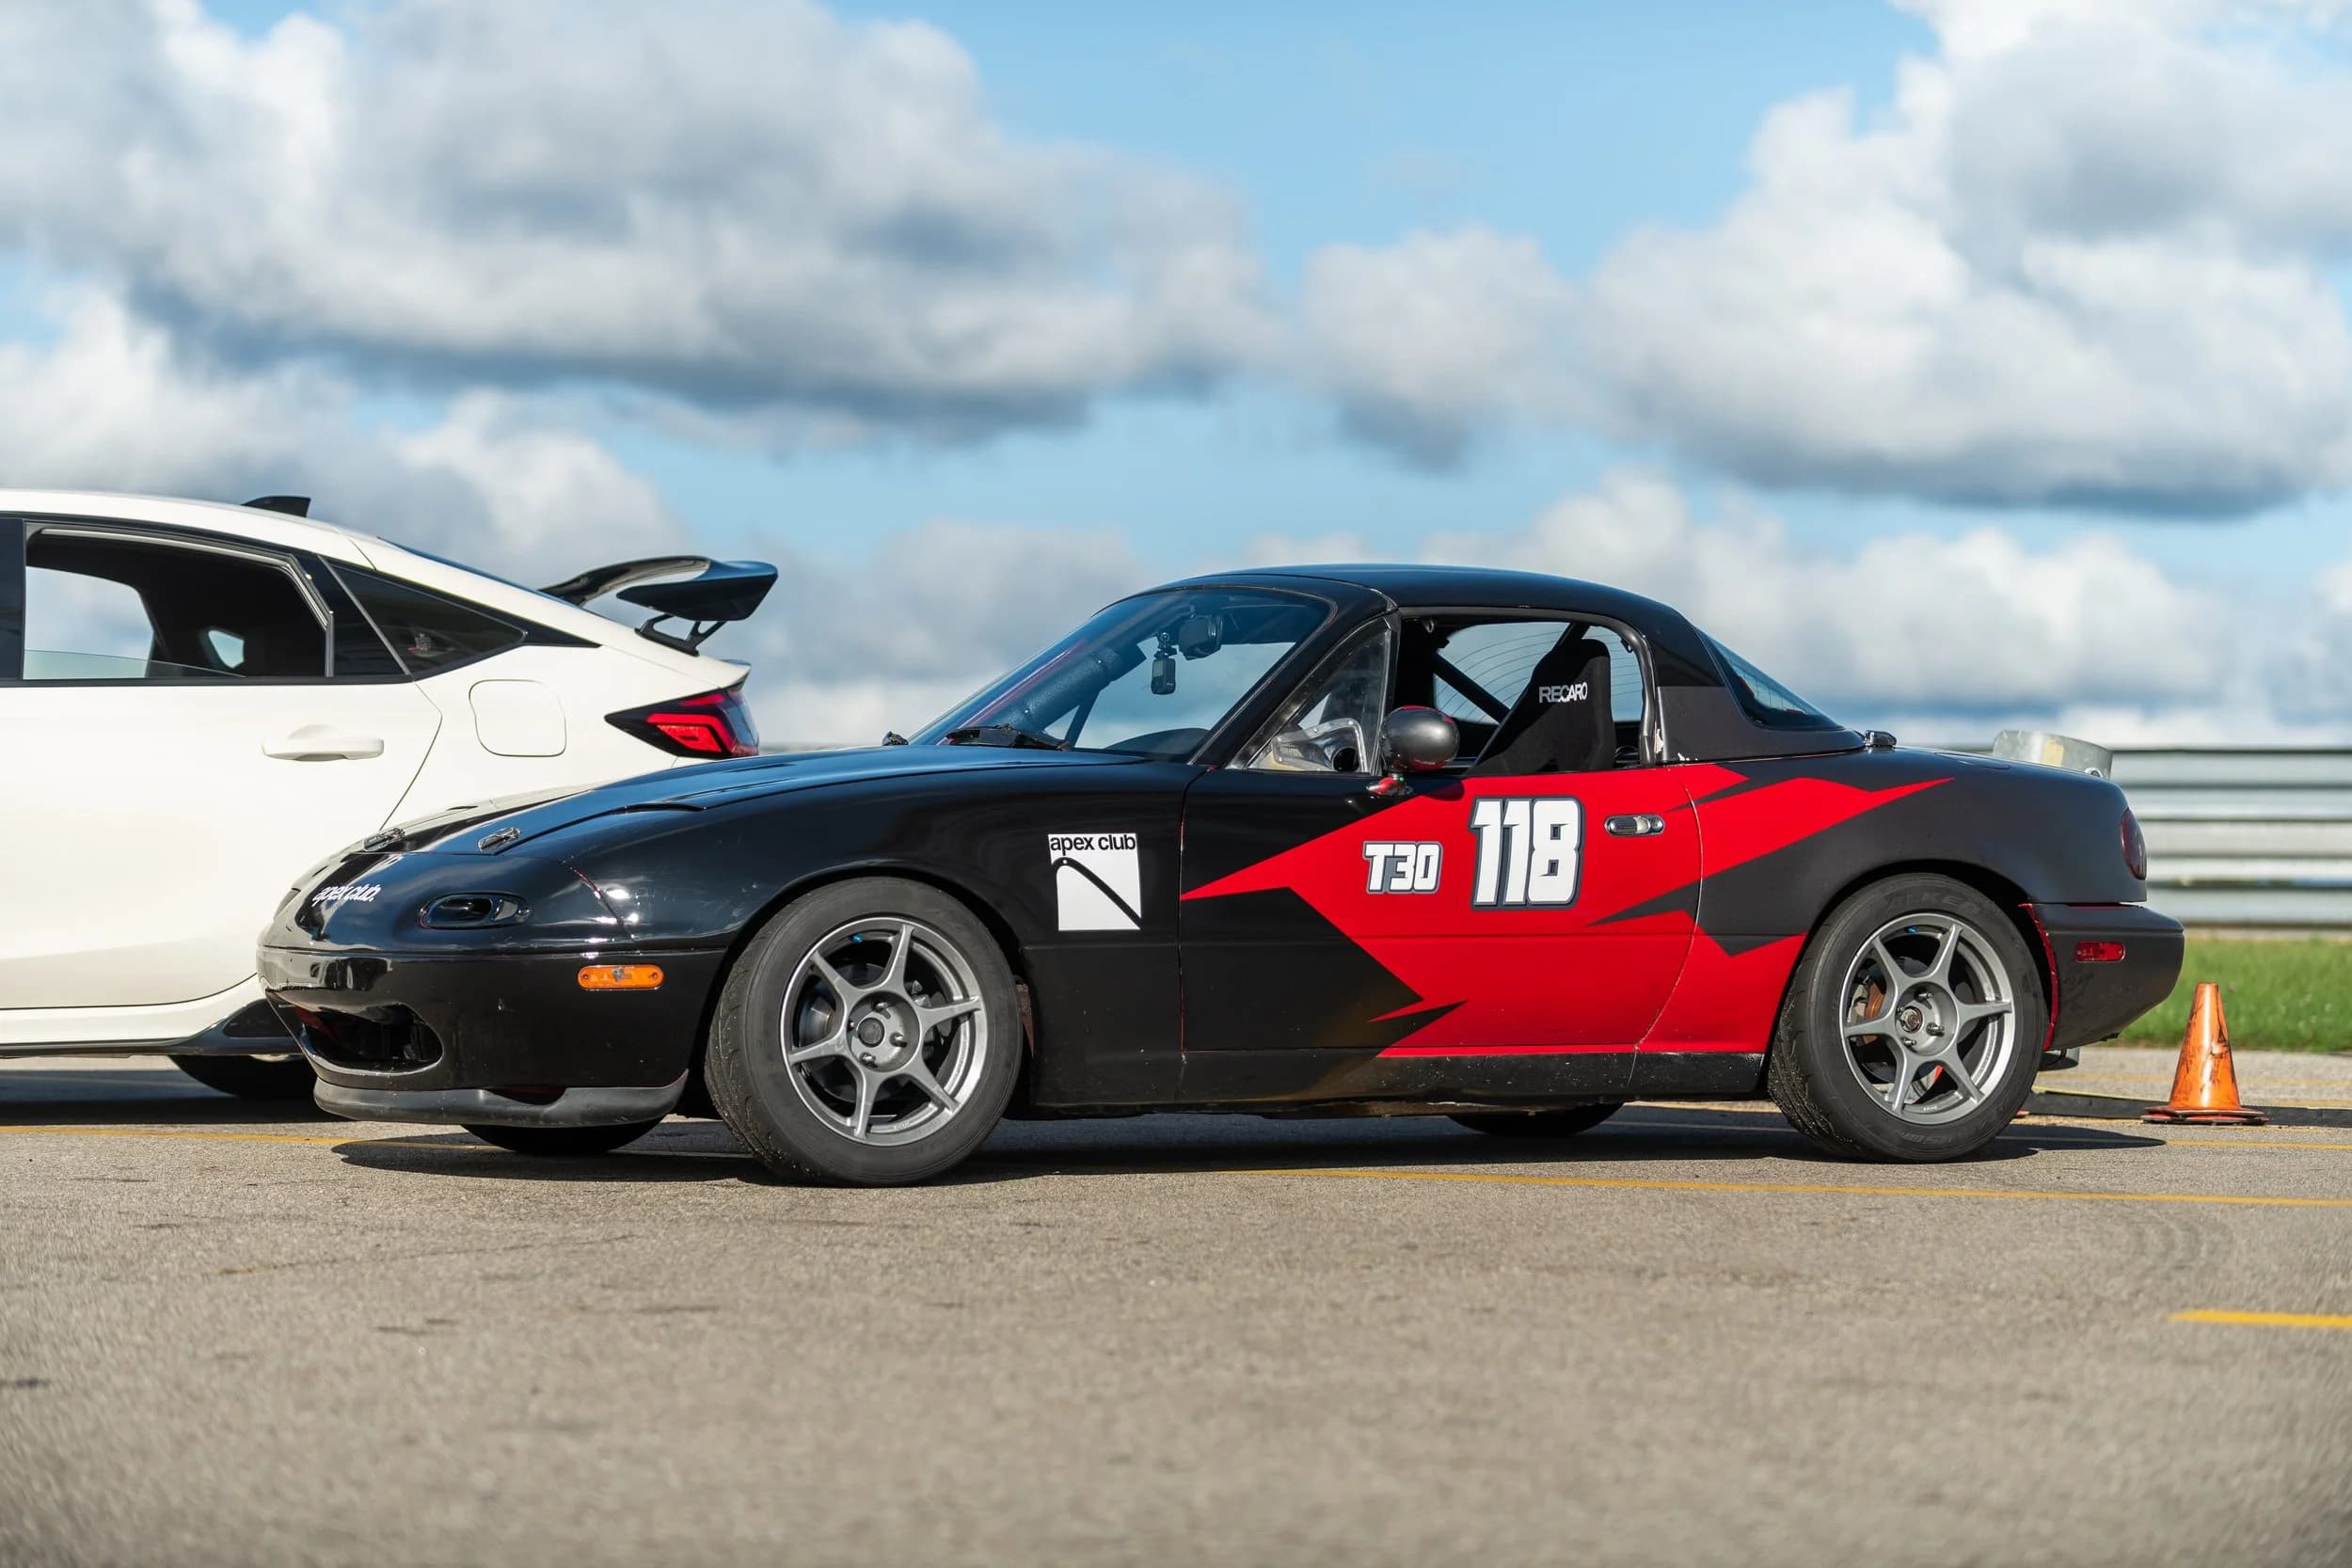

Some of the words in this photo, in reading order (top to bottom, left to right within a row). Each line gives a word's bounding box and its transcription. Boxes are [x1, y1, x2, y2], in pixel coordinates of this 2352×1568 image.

[1538, 681, 1588, 704] RECARO
[1049, 835, 1095, 856] apex
[1097, 833, 1136, 851] club
[1470, 799, 1584, 907] 118
[1363, 842, 1442, 892] T30
